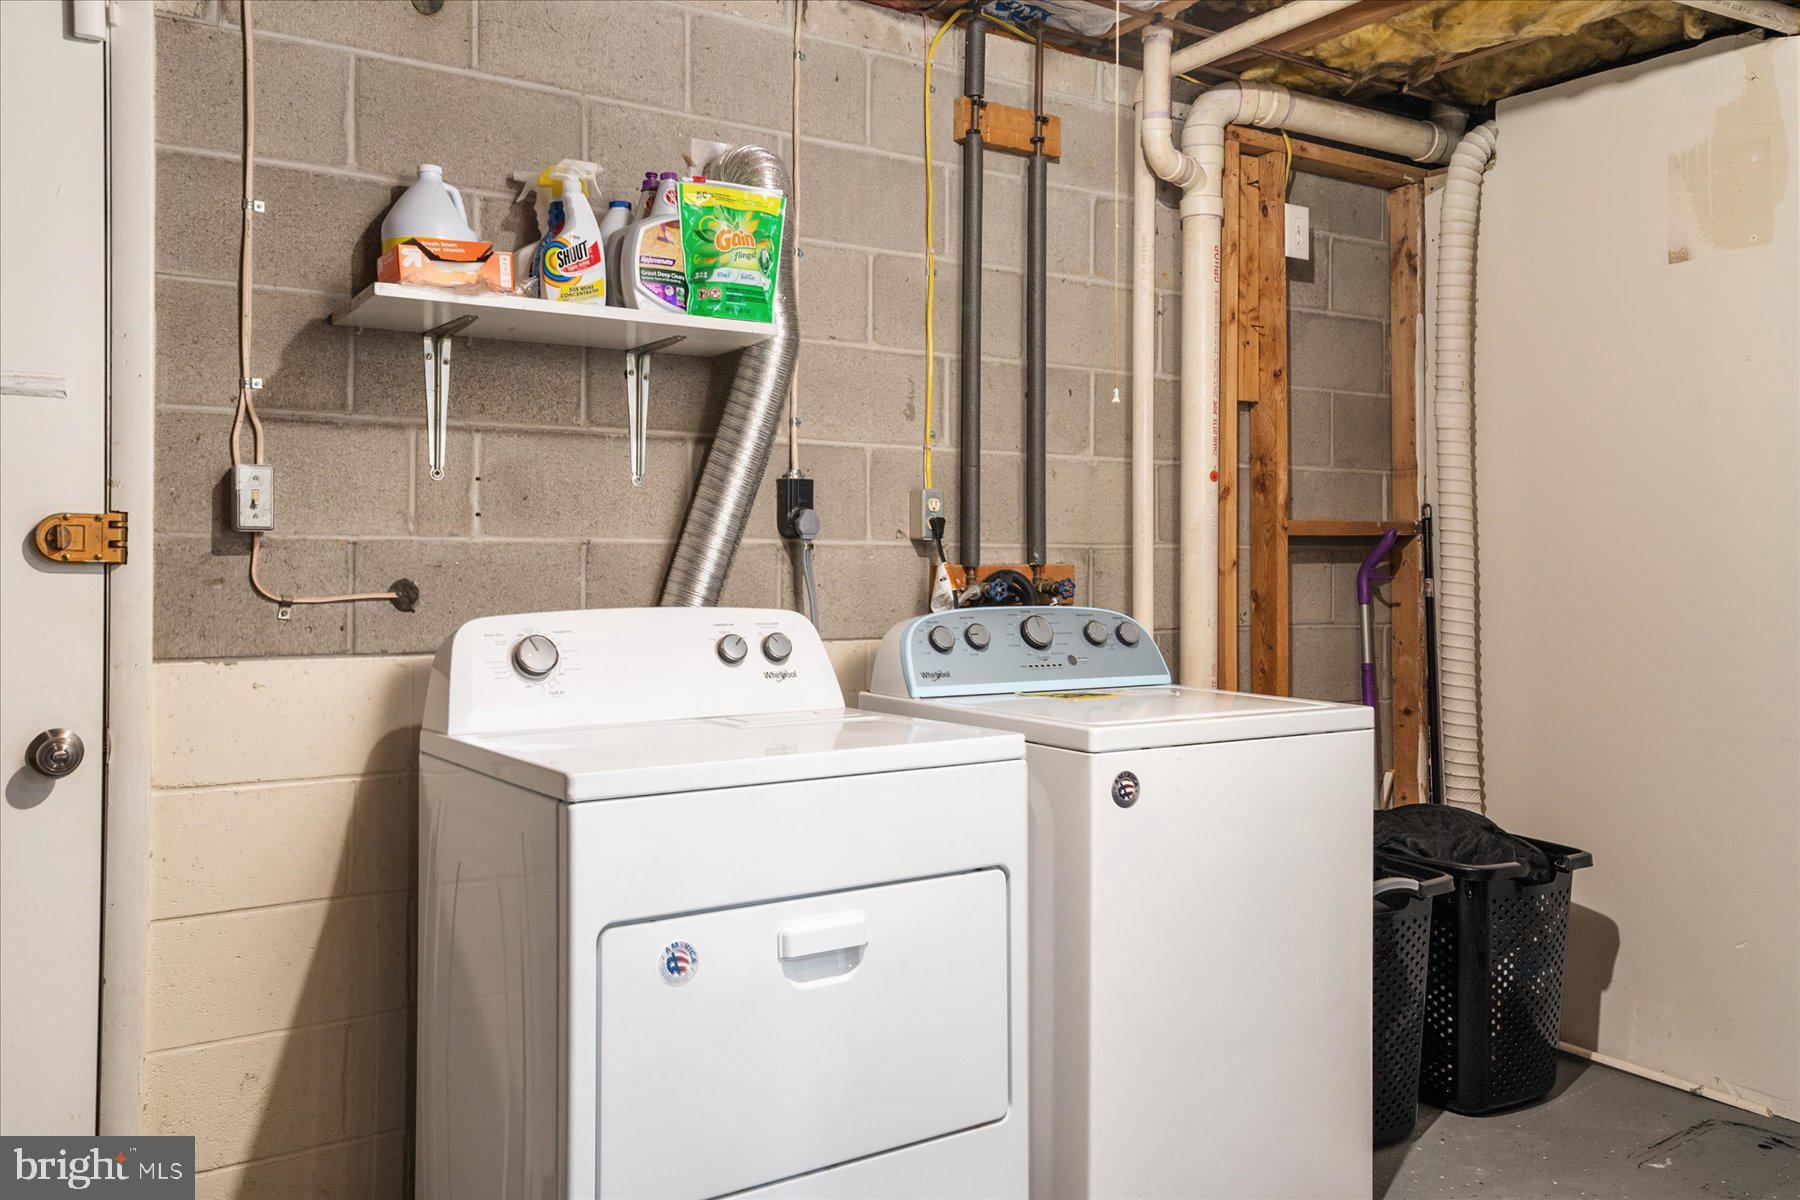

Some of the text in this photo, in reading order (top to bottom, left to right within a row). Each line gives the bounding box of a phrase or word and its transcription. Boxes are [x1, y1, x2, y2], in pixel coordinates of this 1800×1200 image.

[715, 228, 755, 251] Gain
[556, 240, 588, 268] SHOUT
[640, 256, 674, 267] Rejuvenate
[640, 269, 657, 277] Grout
[657, 271, 671, 279] Deep
[763, 668, 797, 682] Whirlpool
[920, 669, 951, 682] Whirlpool
